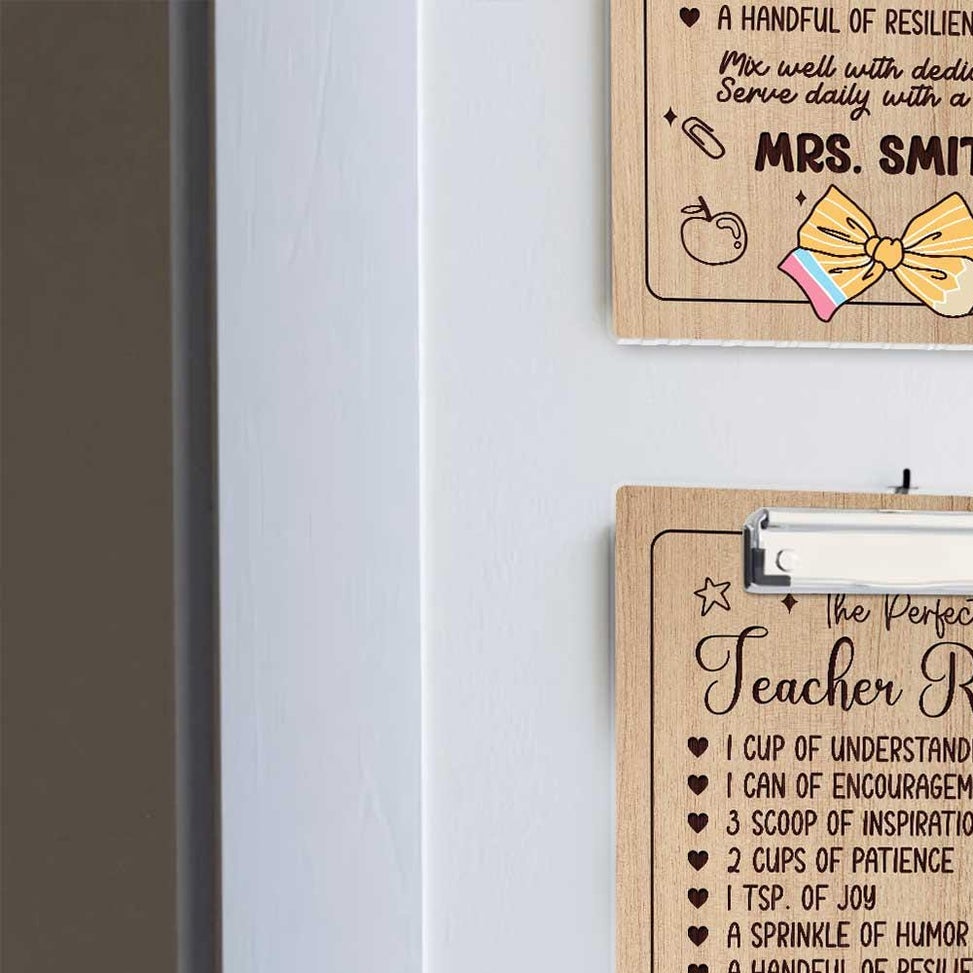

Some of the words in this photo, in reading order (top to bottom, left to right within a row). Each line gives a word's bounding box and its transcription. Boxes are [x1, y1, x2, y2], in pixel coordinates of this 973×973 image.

[717, 4, 732, 31] A
[741, 5, 841, 34] HANDFUL
[849, 7, 877, 34] OF
[718, 50, 771, 80] Mix
[777, 54, 837, 79] well
[844, 55, 904, 80] with
[716, 77, 799, 105] Serve
[805, 82, 871, 121] daily
[882, 83, 942, 108] with
[949, 92, 972, 108] a
[754, 131, 862, 175] MRS.
[695, 625, 902, 716] Teacher
[743, 734, 786, 762] CUP
[794, 734, 823, 762] OF
[743, 771, 786, 799] CAN
[796, 771, 824, 799] OF
[726, 809, 740, 836] 3
[751, 809, 818, 836] SCOOP
[826, 809, 854, 837] OF
[727, 846, 741, 874] 2
[752, 846, 806, 874] CUPS
[815, 846, 844, 874] OF
[852, 846, 955, 874] PATIENCE
[742, 884, 790, 912] TSP.
[801, 883, 829, 911] OF
[836, 884, 876, 911] JOY
[727, 921, 741, 949] A
[750, 920, 851, 949] SPRINKLE
[860, 920, 887, 948] OF
[896, 920, 969, 948] HUMOR
